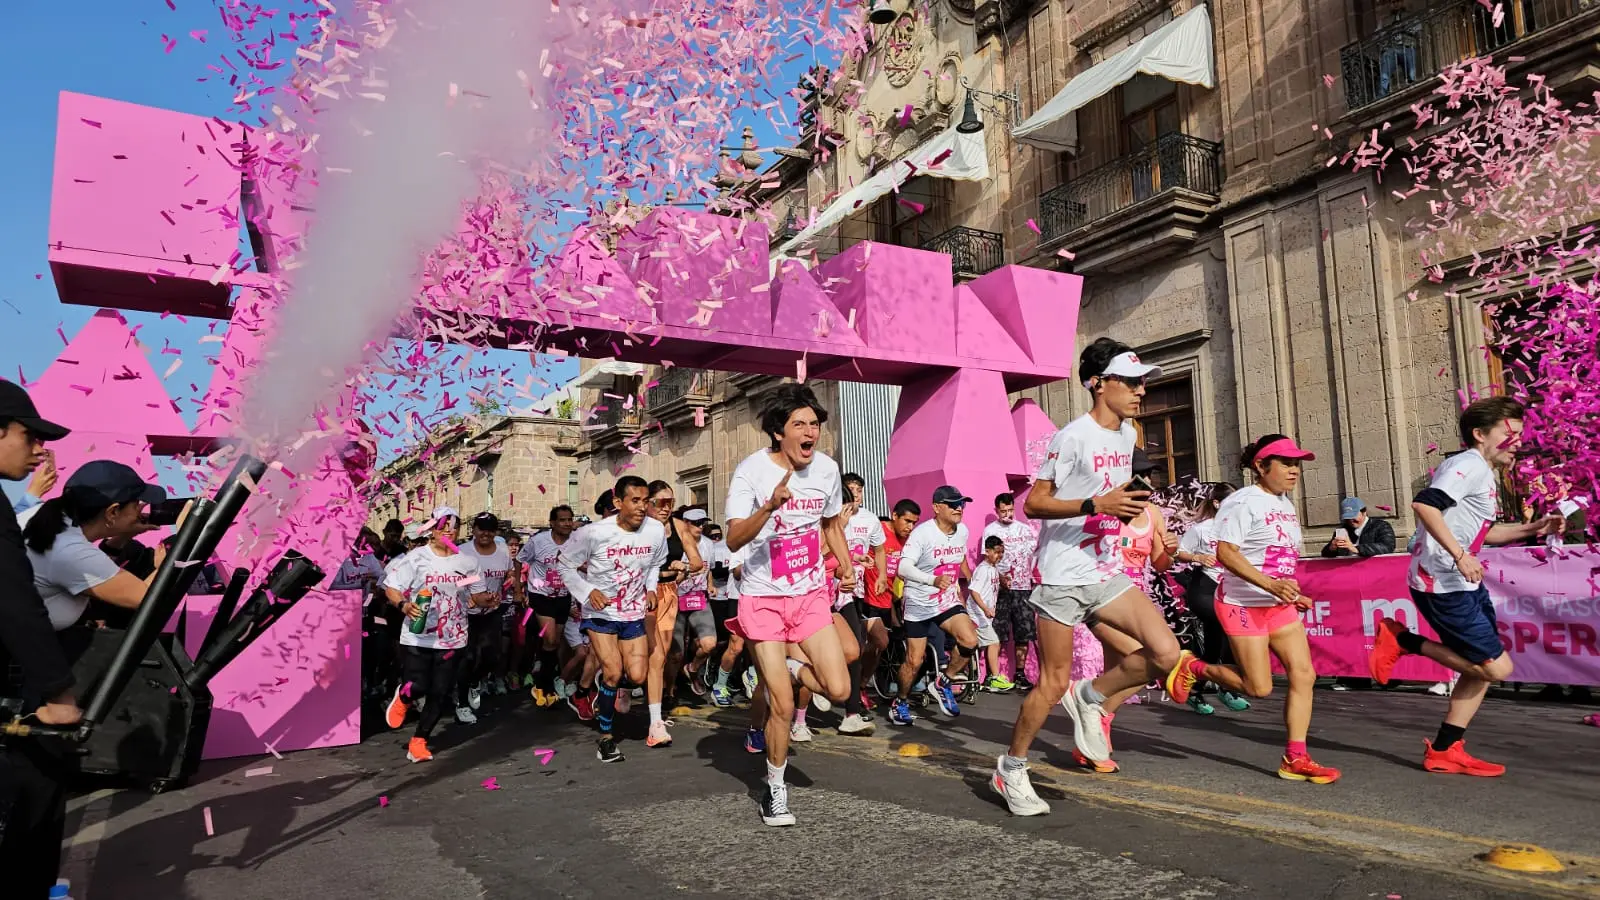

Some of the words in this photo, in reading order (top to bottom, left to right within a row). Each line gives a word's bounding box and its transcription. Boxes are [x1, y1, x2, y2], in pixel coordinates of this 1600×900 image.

[1099, 520, 1119, 529] 0060
[607, 544, 652, 558] pinkTATE
[787, 556, 810, 569] 1008
